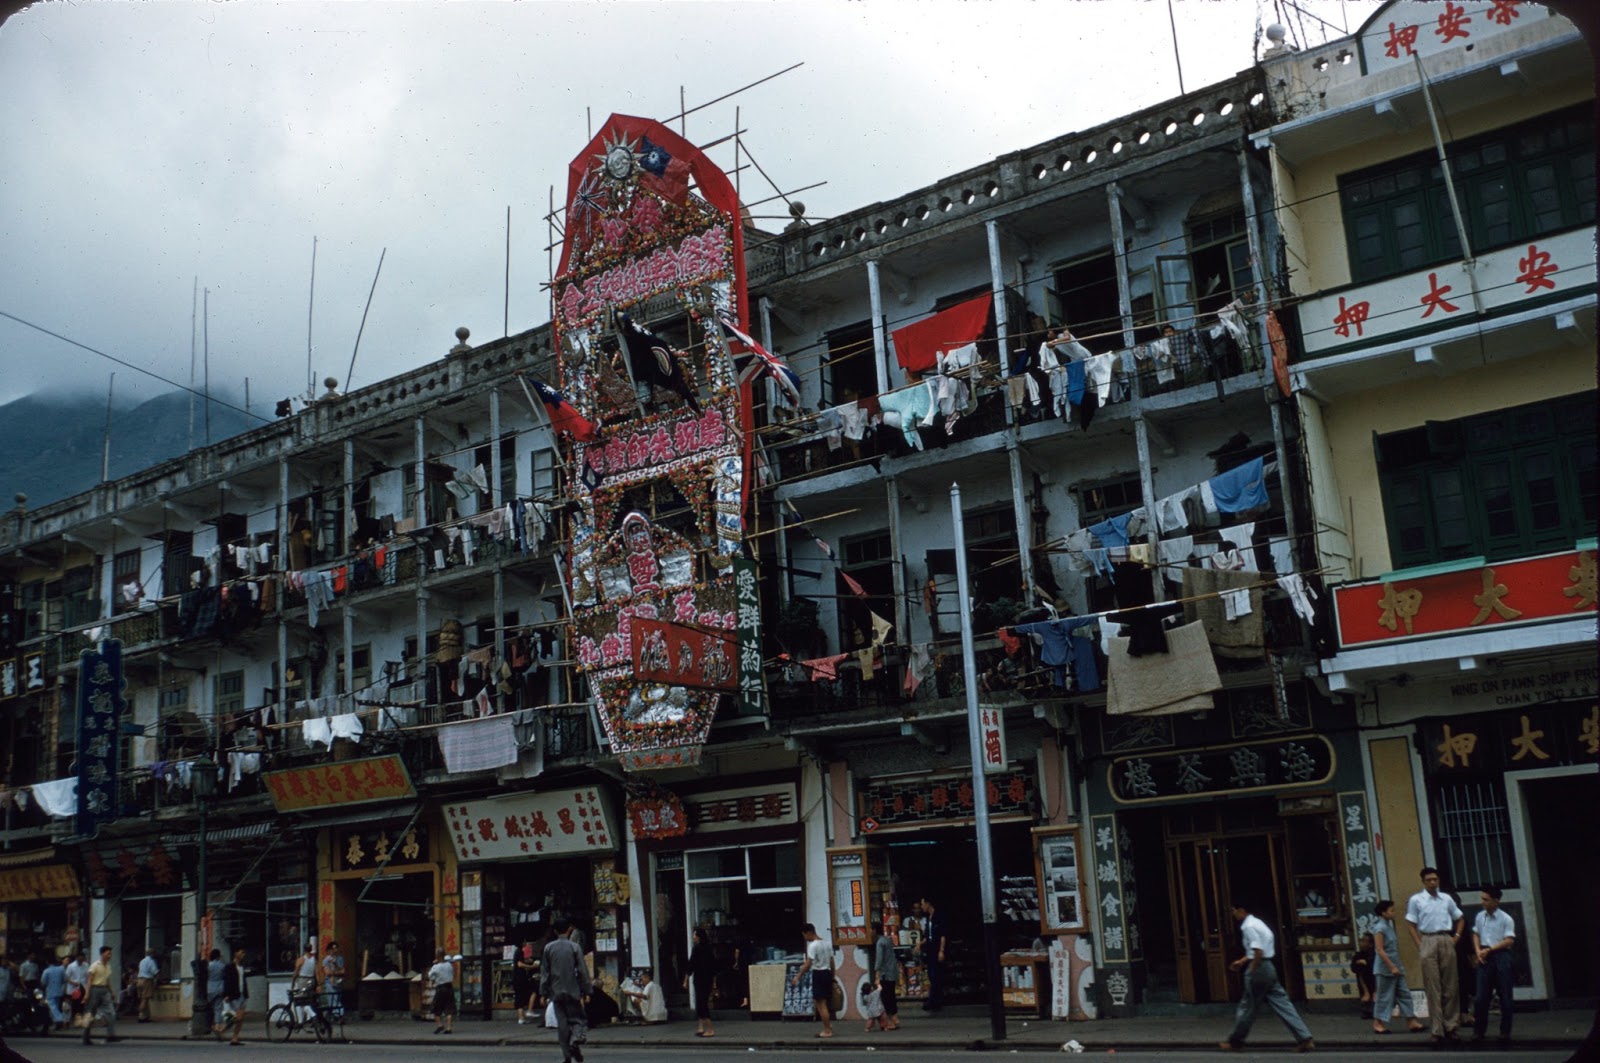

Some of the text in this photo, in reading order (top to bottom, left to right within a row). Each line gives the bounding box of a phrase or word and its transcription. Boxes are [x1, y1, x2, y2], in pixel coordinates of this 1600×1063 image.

[1334, 245, 1558, 338] 安大押
[1503, 675, 1535, 691] PAWN
[1538, 671, 1570, 687] SHOP
